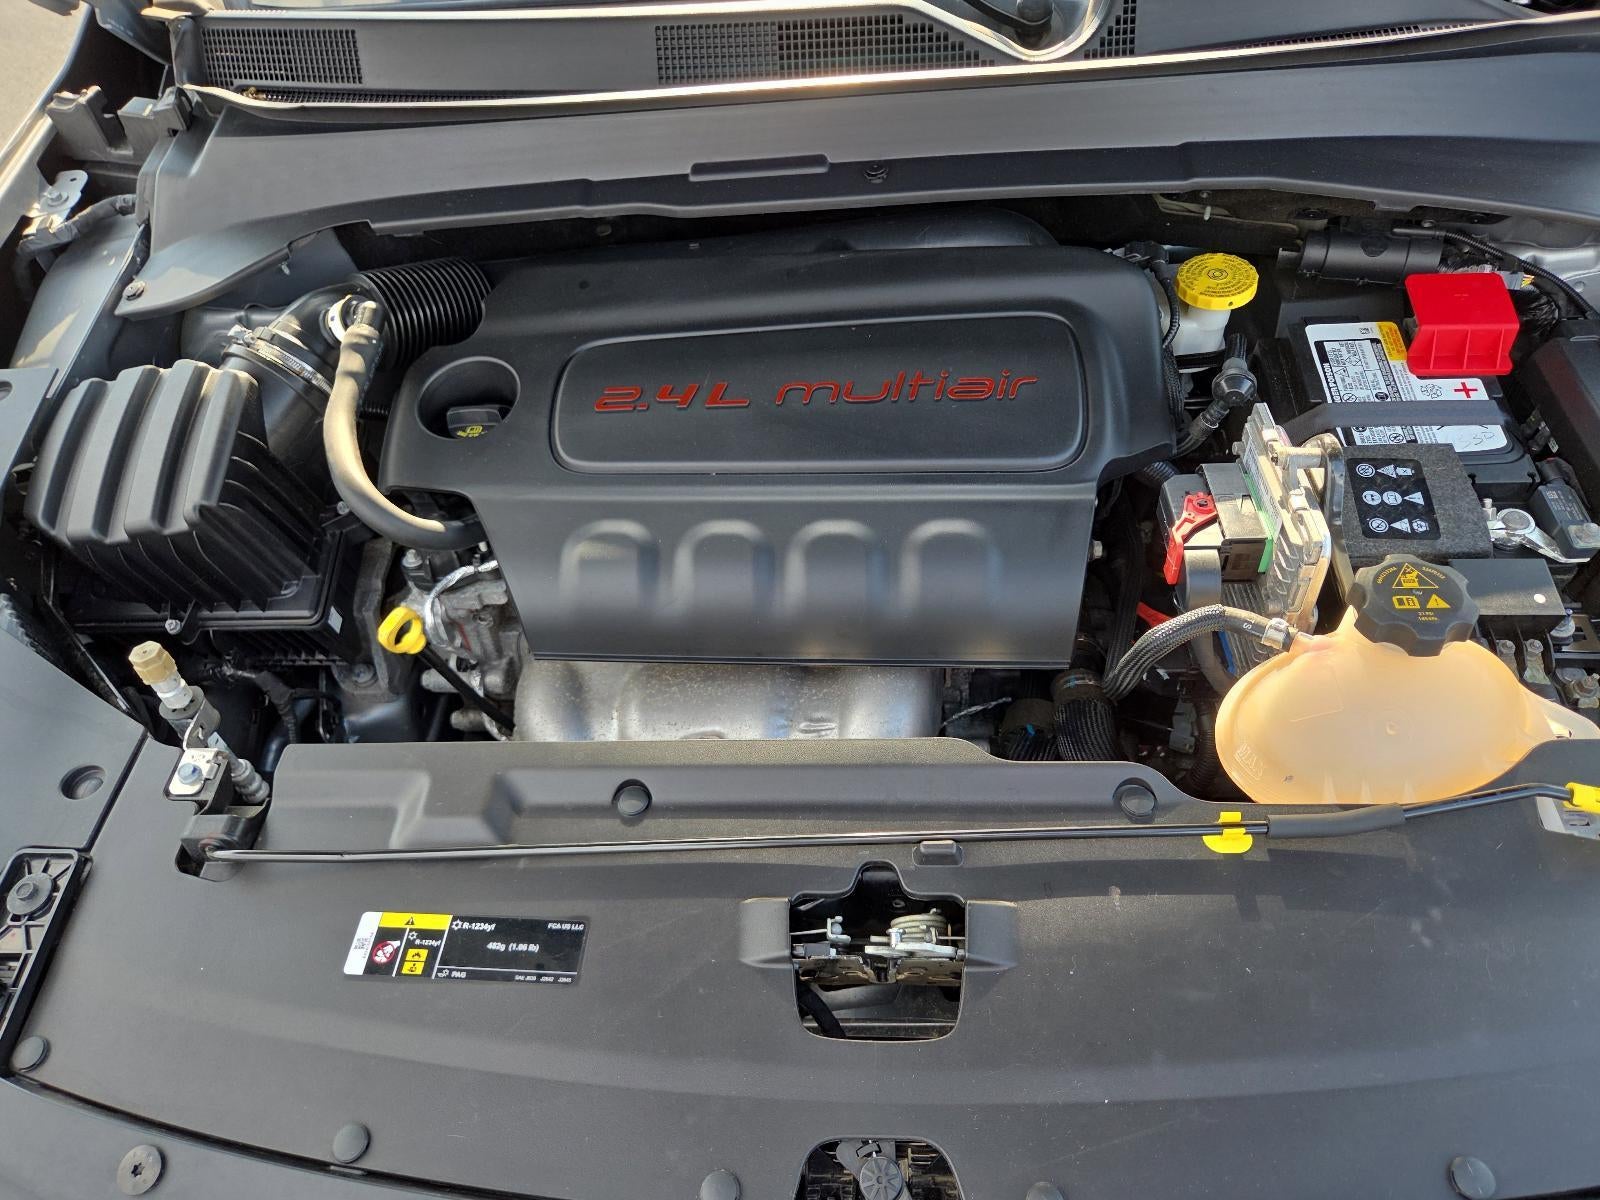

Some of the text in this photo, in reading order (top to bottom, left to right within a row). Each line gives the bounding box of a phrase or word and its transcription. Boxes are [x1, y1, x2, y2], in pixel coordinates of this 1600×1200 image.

[1322, 362, 1338, 388] POISON
[594, 369, 1039, 412] 2.4L multiair
[463, 922, 496, 932] R-1234yf
